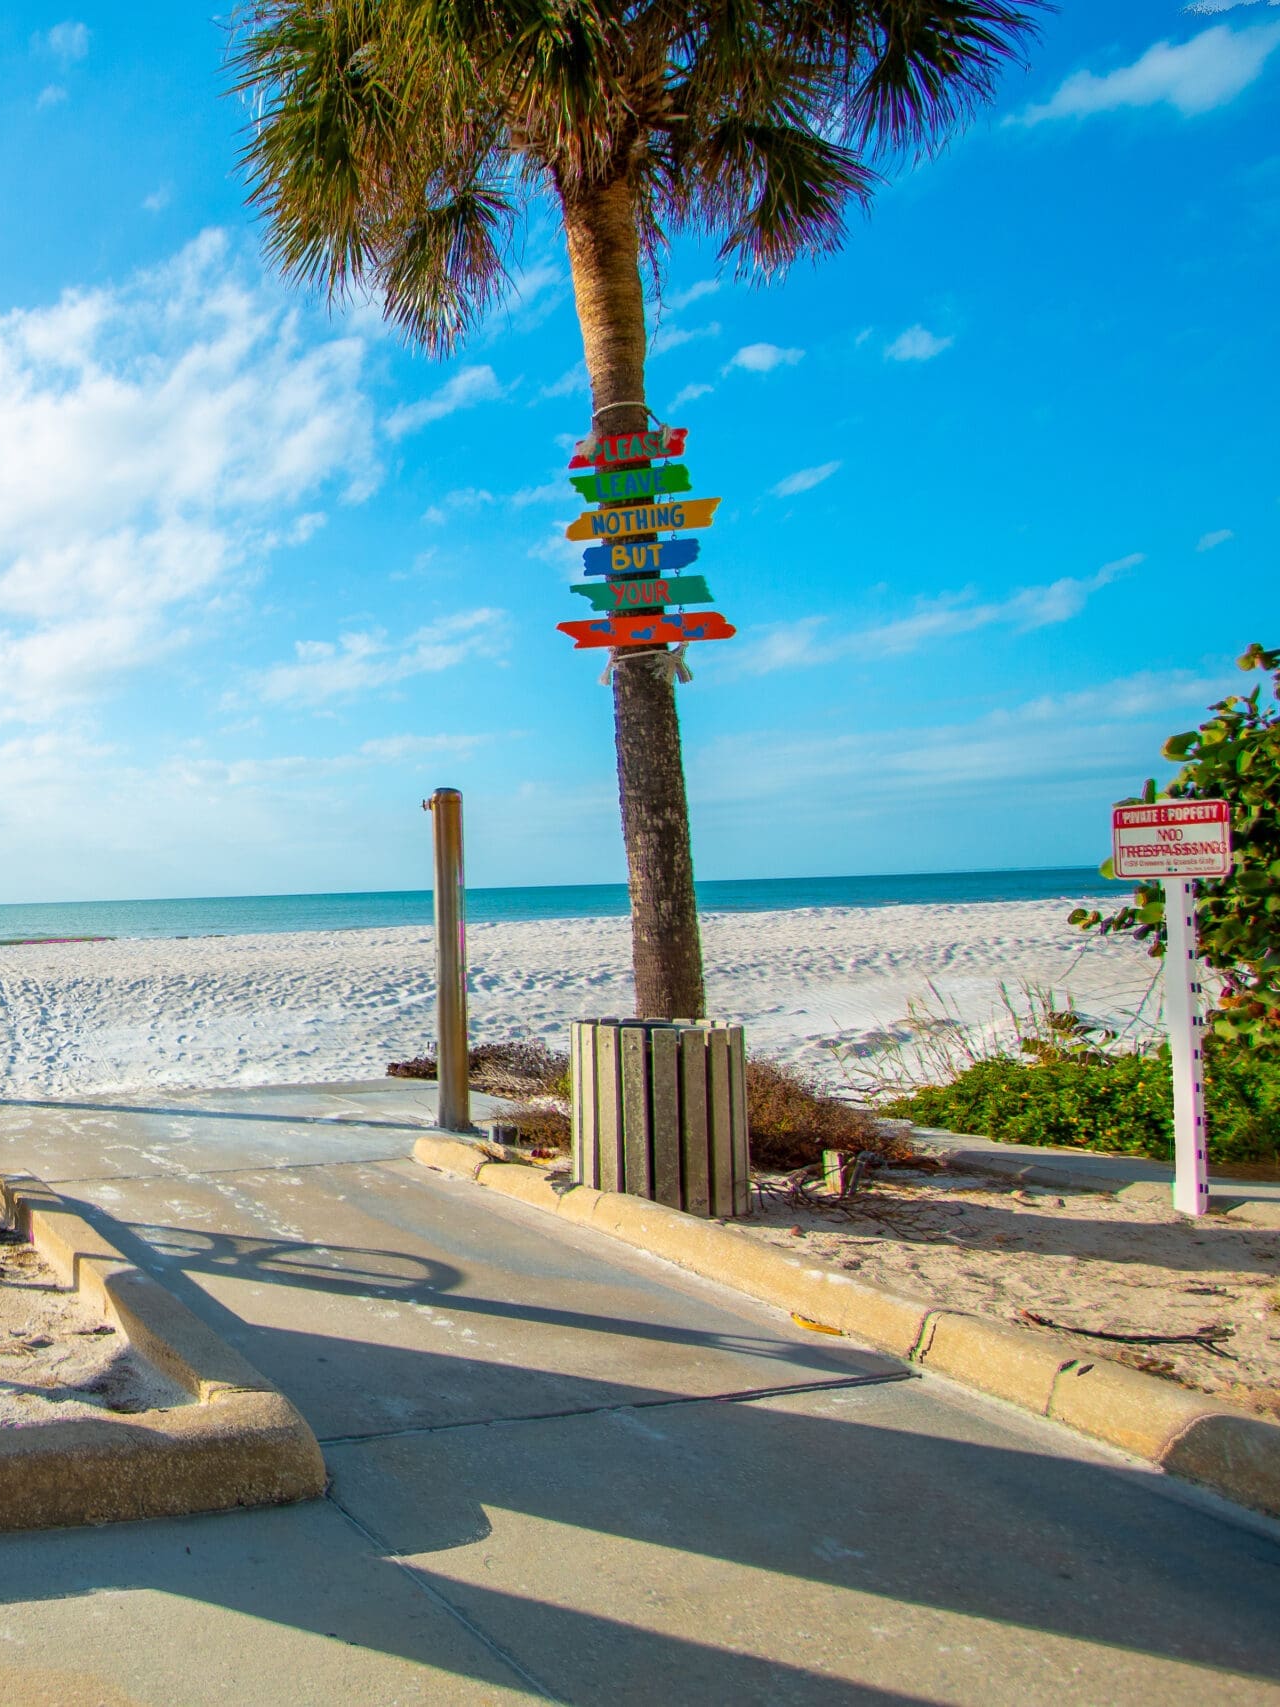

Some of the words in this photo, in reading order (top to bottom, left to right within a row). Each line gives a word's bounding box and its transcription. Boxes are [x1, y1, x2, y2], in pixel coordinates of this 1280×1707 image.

[588, 434, 672, 464] PLEASE
[595, 468, 667, 498] LEAVE
[591, 505, 685, 535] NOTHING
[611, 544, 664, 570] BUT
[609, 579, 672, 607] YOUR
[1157, 828, 1184, 842] NO
[1120, 842, 1226, 858] TRESPASSING
